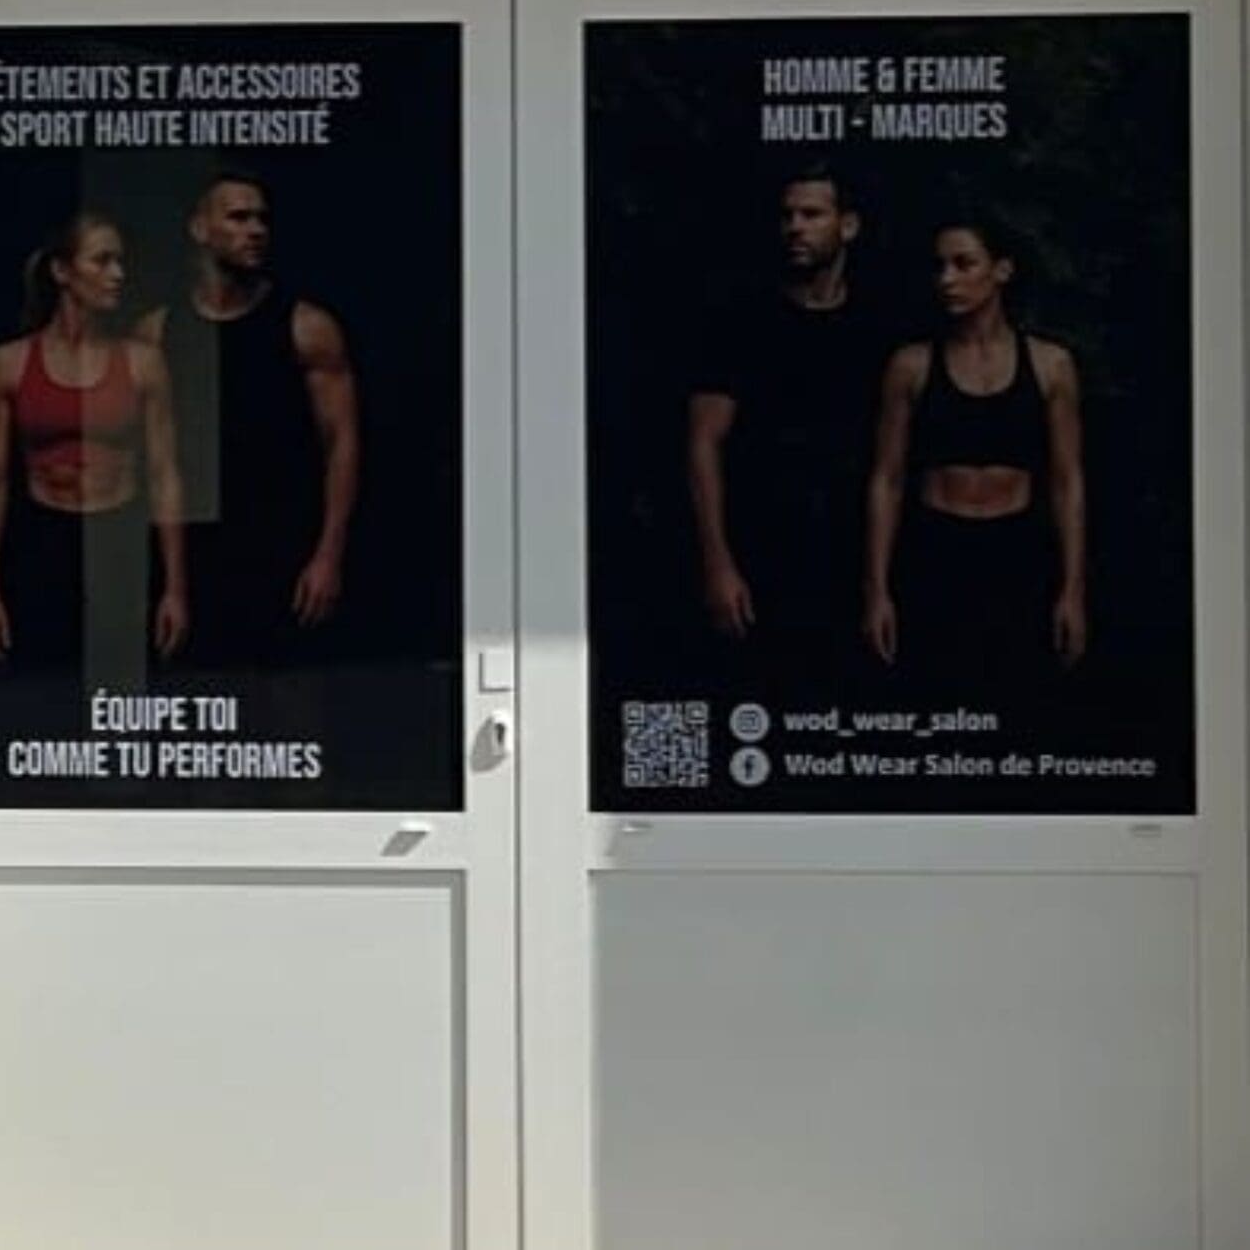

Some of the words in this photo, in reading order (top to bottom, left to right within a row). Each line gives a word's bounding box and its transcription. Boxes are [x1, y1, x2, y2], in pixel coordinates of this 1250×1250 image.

[137, 65, 170, 100] ET
[177, 63, 361, 100] ACCESSOIRES
[763, 57, 870, 94] HOMME
[877, 58, 896, 93] &
[903, 56, 1006, 92] FEMME
[0, 110, 88, 147] SPORT
[95, 110, 183, 147] HAUTE
[189, 102, 330, 145] INTENSITÉ
[761, 104, 844, 141] MULTI
[871, 103, 1008, 141] MARQUES
[91, 688, 187, 732] ÉQUIPE
[193, 696, 237, 731] TOI
[783, 707, 999, 738] wod_wear_salon
[8, 741, 110, 777] COMME
[116, 741, 151, 777] TU
[158, 742, 322, 779] PERFORMES
[784, 753, 845, 776] Wod
[850, 753, 919, 776] Wear
[925, 753, 994, 776] Salon
[999, 753, 1032, 776] de
[1038, 753, 1157, 777] Provence
